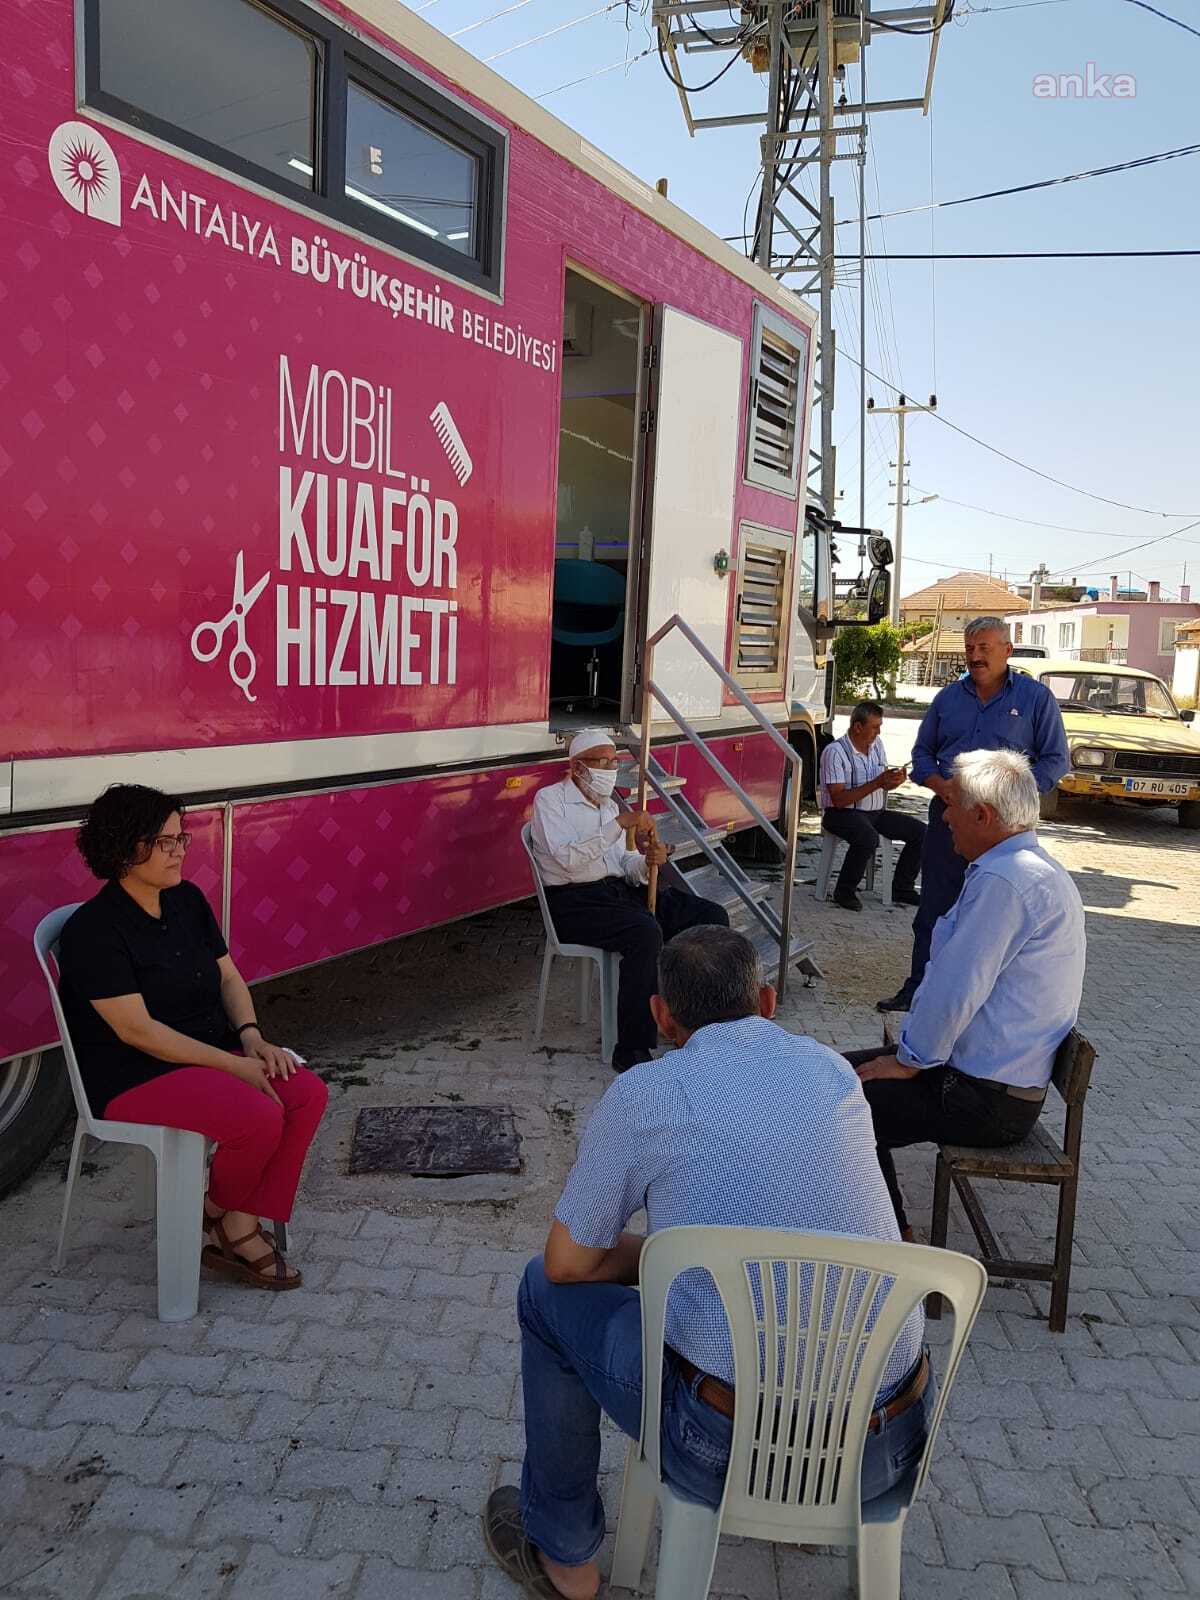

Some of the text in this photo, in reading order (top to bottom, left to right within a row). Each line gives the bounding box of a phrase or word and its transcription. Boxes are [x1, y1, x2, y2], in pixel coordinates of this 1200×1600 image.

[130, 174, 557, 373] ANTALYA BÜYÜKŞEHİR BELEDİYESİ
[278, 466, 458, 589] KUAFÖR
[1133, 781, 1146, 791] 07
